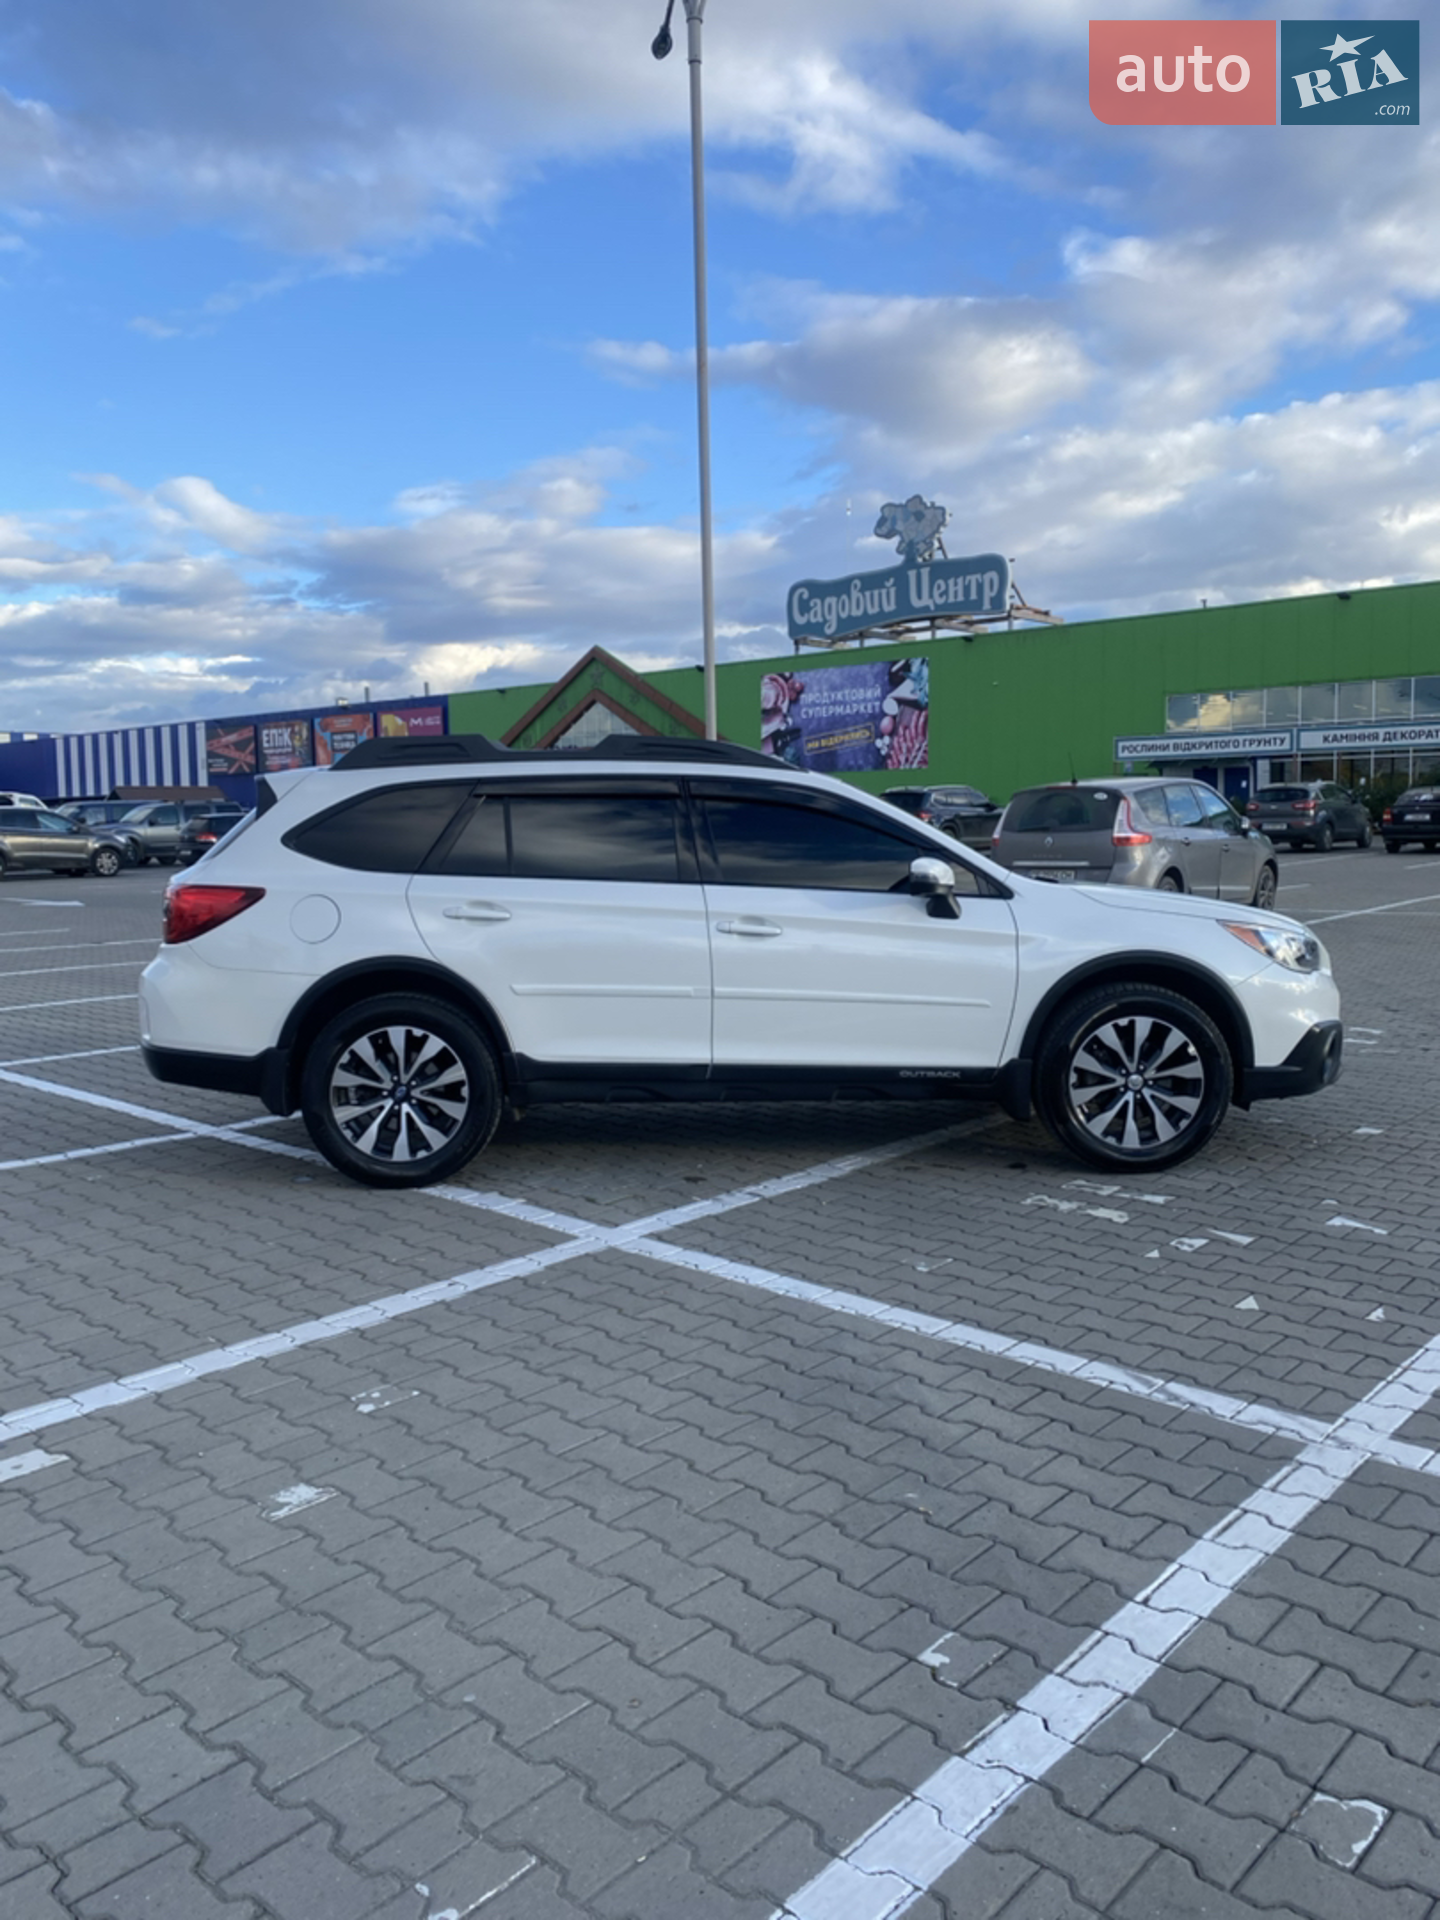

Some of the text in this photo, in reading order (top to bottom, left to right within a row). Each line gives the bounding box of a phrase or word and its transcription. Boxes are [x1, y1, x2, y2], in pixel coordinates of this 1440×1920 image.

[791, 567, 1000, 635] Садовий Центр
[800, 684, 882, 705] ПРОДУКТОВИЙ
[801, 701, 881, 719] СУПЕРМАРКЕТ
[1121, 736, 1287, 754] РОСЛИНИ ВІДКРИТОГО ГРУНТУ
[1322, 731, 1379, 744] КАМІННЯ
[898, 1069, 962, 1079] OUTBACK
